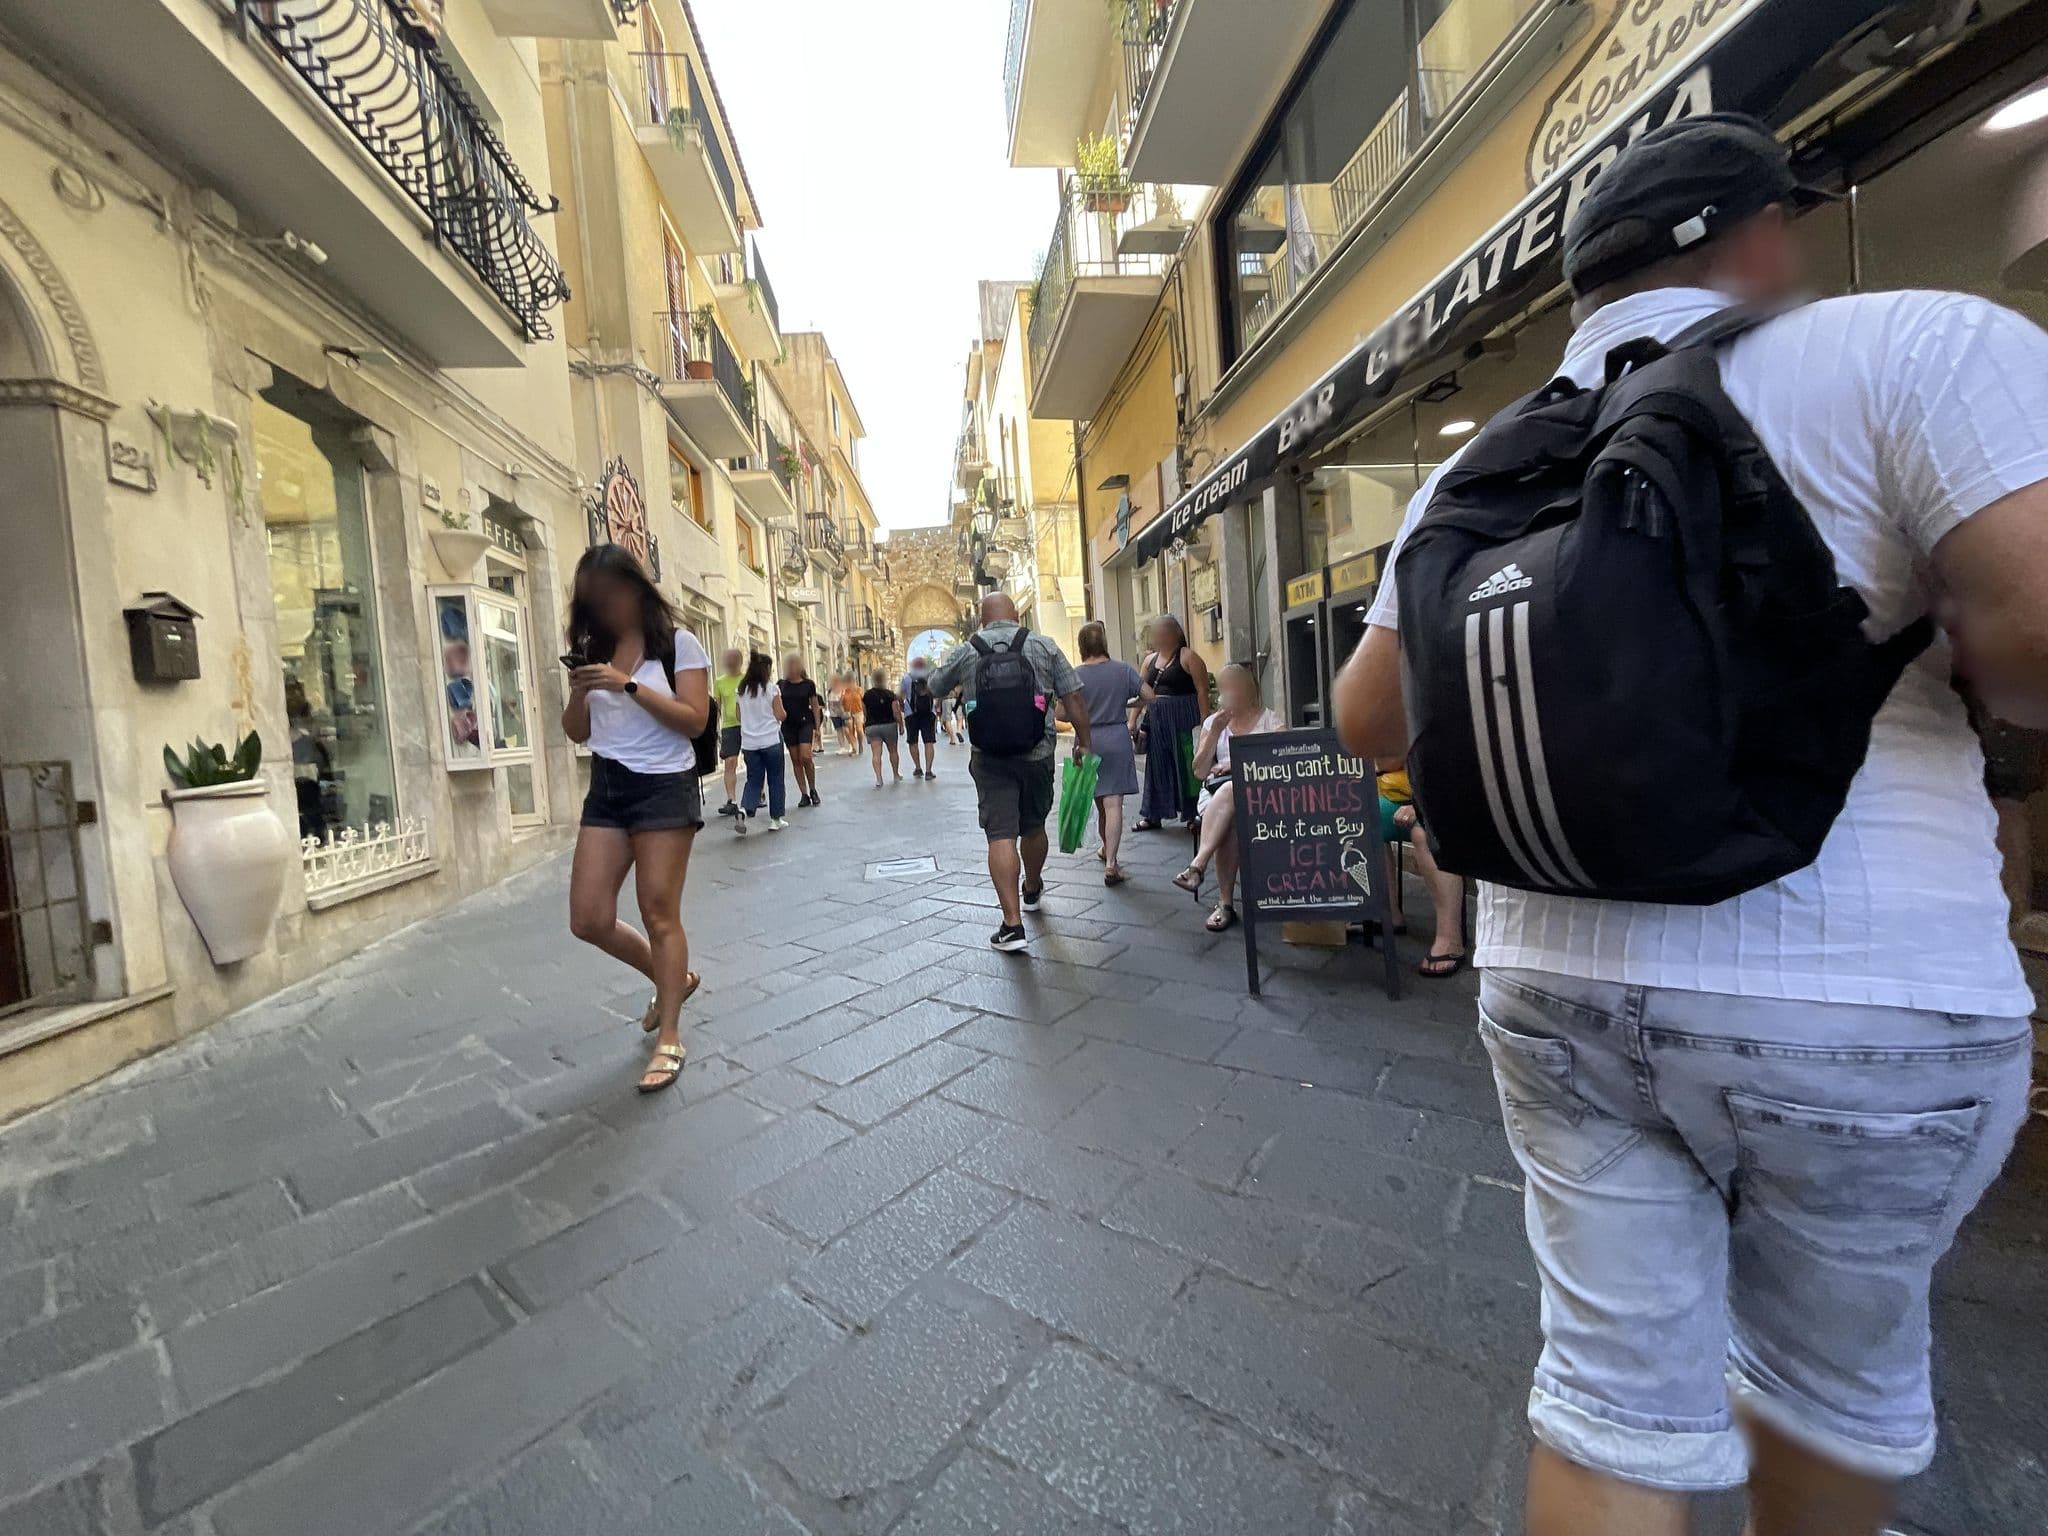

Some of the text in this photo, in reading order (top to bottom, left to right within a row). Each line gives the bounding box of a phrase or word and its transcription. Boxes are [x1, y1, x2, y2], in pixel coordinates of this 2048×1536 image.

[1171, 504, 1191, 534] ice
[1194, 458, 1249, 515] cream
[484, 518, 520, 553] EFFE
[1294, 581, 1316, 601] ATM
[1468, 576, 1532, 602] adidas
[1243, 753, 1364, 782] Money can't buy
[1246, 780, 1362, 816] HAPPINESS
[1252, 816, 1364, 844] But it can Buy
[1267, 870, 1349, 893] CREAM
